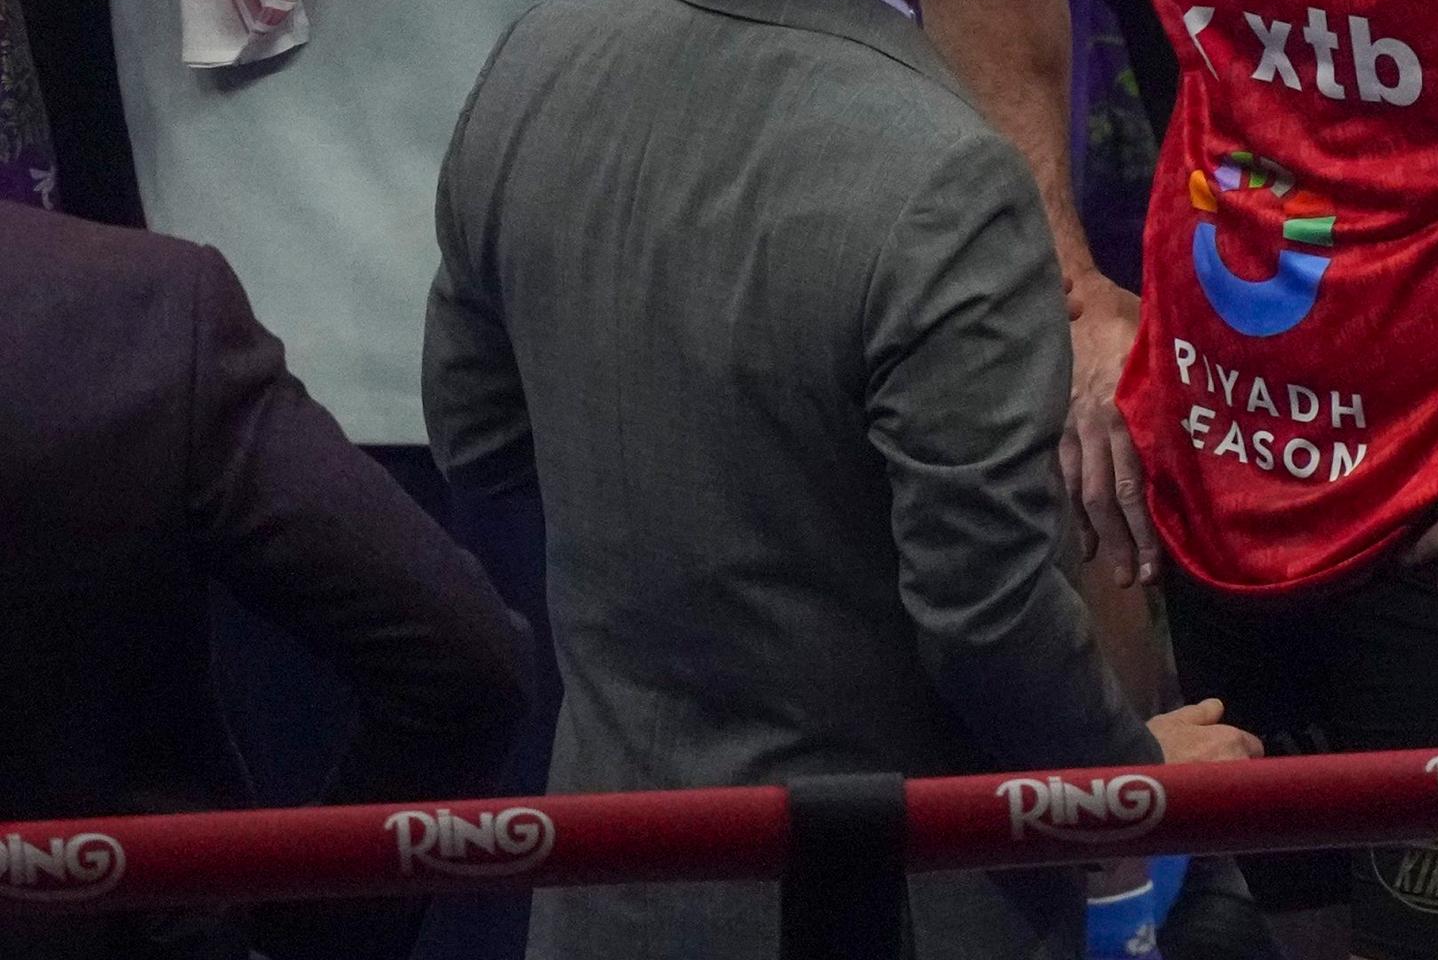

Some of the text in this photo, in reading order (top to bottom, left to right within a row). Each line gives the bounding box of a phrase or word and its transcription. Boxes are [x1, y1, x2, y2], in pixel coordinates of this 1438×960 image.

[1243, 6, 1424, 108] xtb
[1174, 337, 1367, 429] RIYADH
[1180, 404, 1368, 482] EASON
[384, 807, 556, 876] RING
[996, 774, 1167, 842] RING
